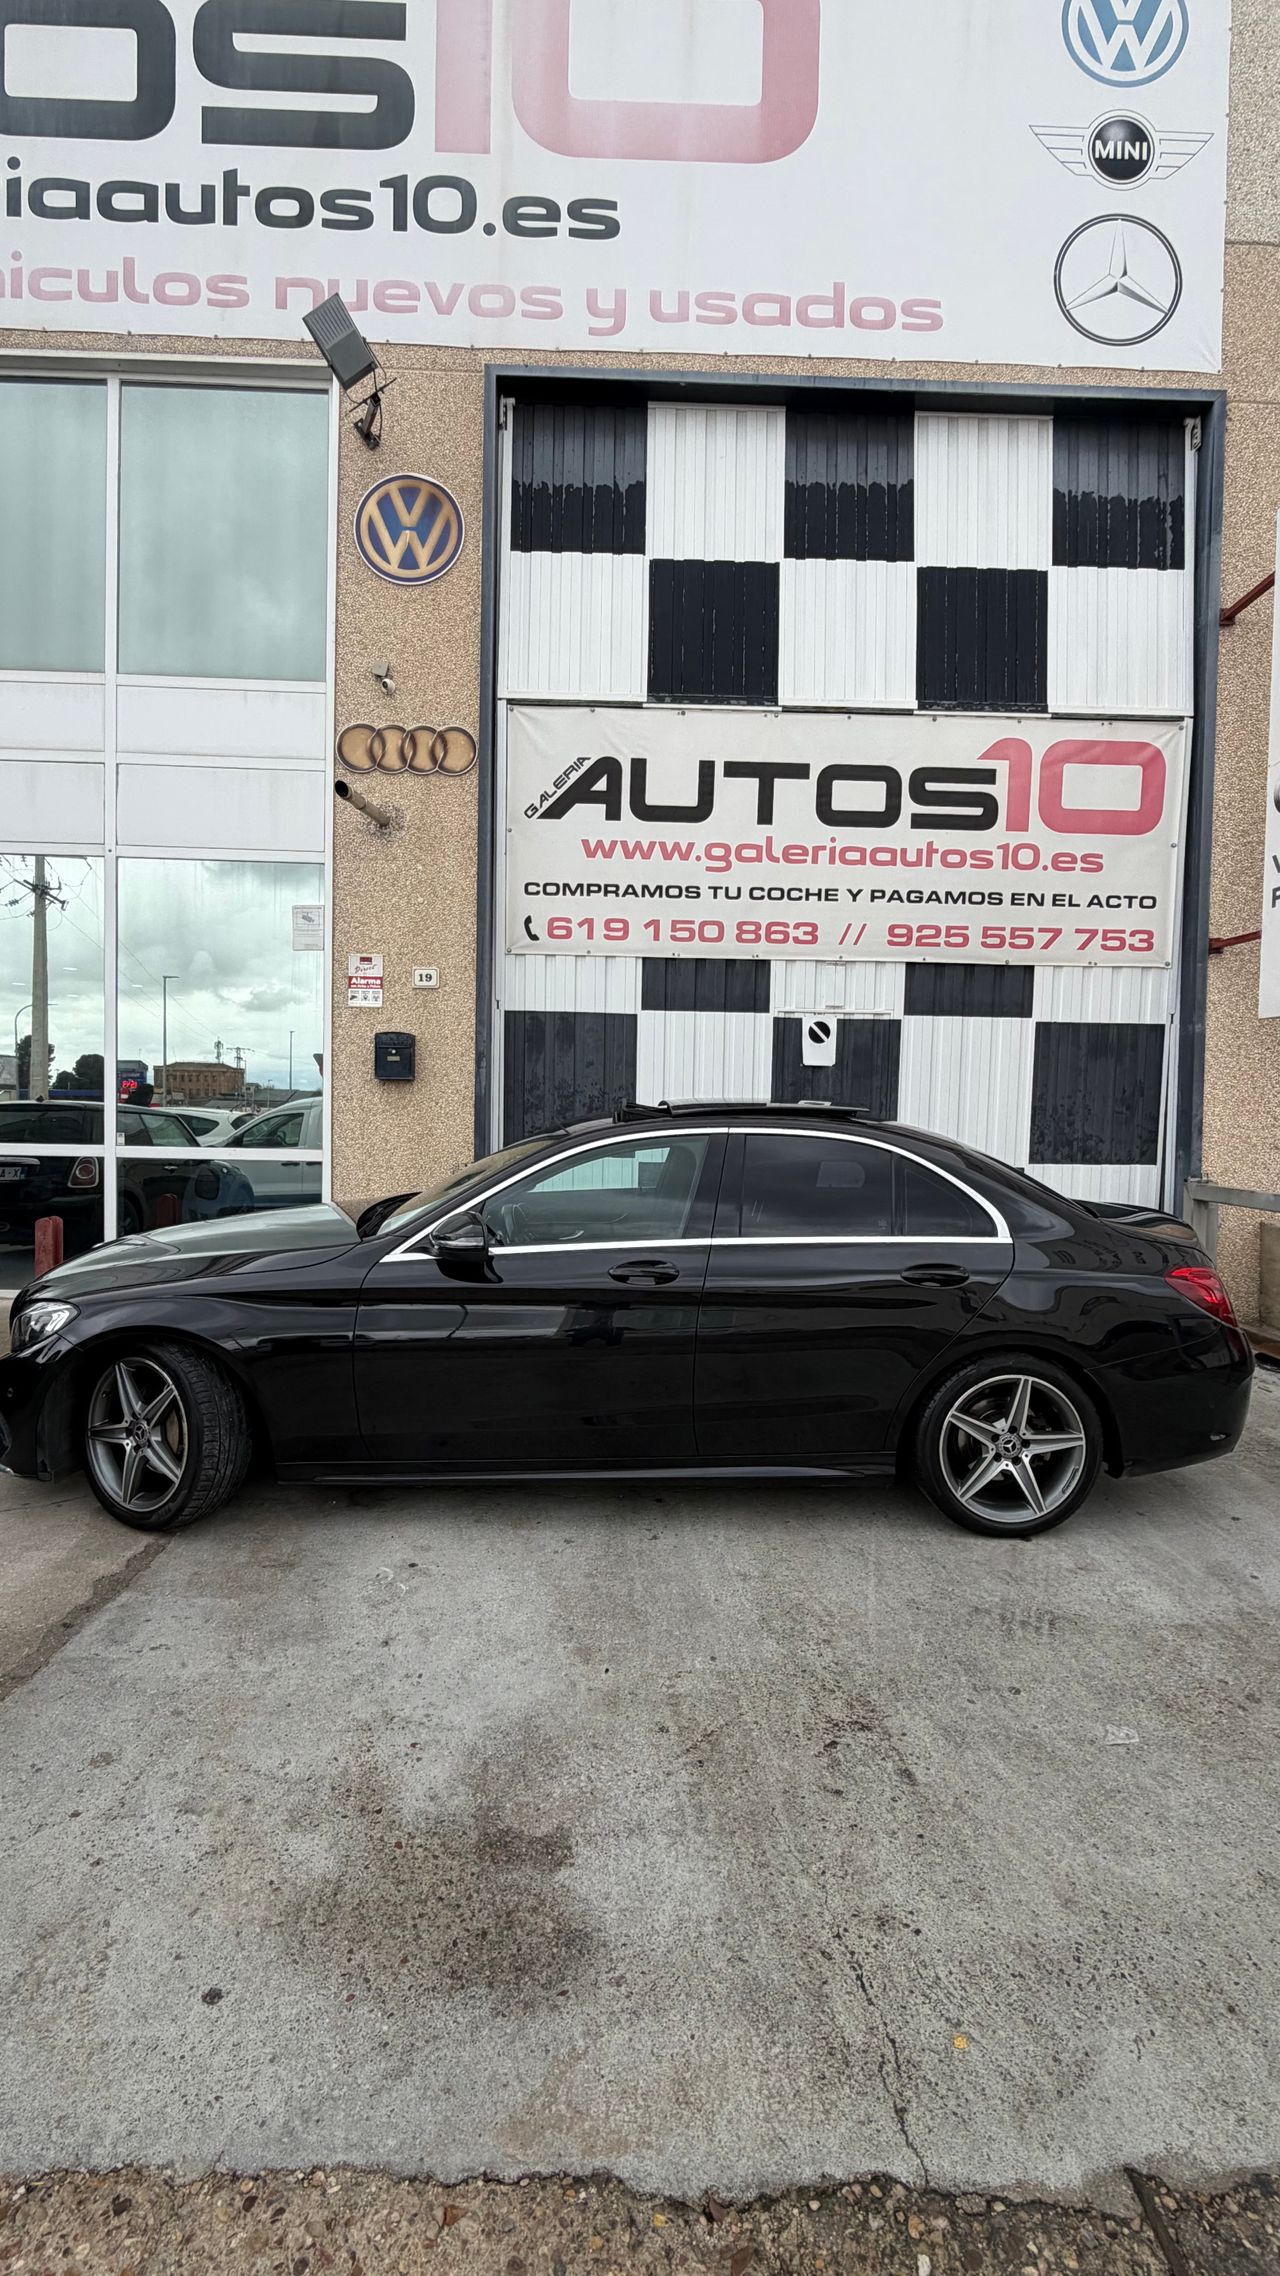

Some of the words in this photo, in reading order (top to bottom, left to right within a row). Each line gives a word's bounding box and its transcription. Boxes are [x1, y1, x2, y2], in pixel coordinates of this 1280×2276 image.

[1094, 139, 1148, 161] MINI
[6, 156, 621, 240] iaautos10.es
[275, 277, 564, 321] nuevos
[586, 287, 627, 337] y
[649, 281, 944, 332] usados
[523, 757, 592, 820] GALERIA
[537, 737, 1167, 836] AUTOS10
[581, 835, 1104, 874] www.galeriaautos10.es
[523, 881, 700, 900] COMPRAMOS
[707, 886, 742, 900] TU
[749, 886, 839, 902] COCHE
[846, 888, 864, 903] Y
[870, 889, 1004, 906] PAGAMOS
[1010, 892, 1045, 908] EN
[1051, 893, 1081, 909] EL
[1086, 894, 1158, 910] ACTO
[546, 916, 630, 942] 619
[643, 918, 725, 944] 150
[735, 921, 820, 946] 863
[886, 923, 970, 948] 925
[980, 925, 1063, 950] 557
[1074, 927, 1155, 952] 753
[350, 976, 381, 984] Alarma
[418, 973, 433, 983] 19
